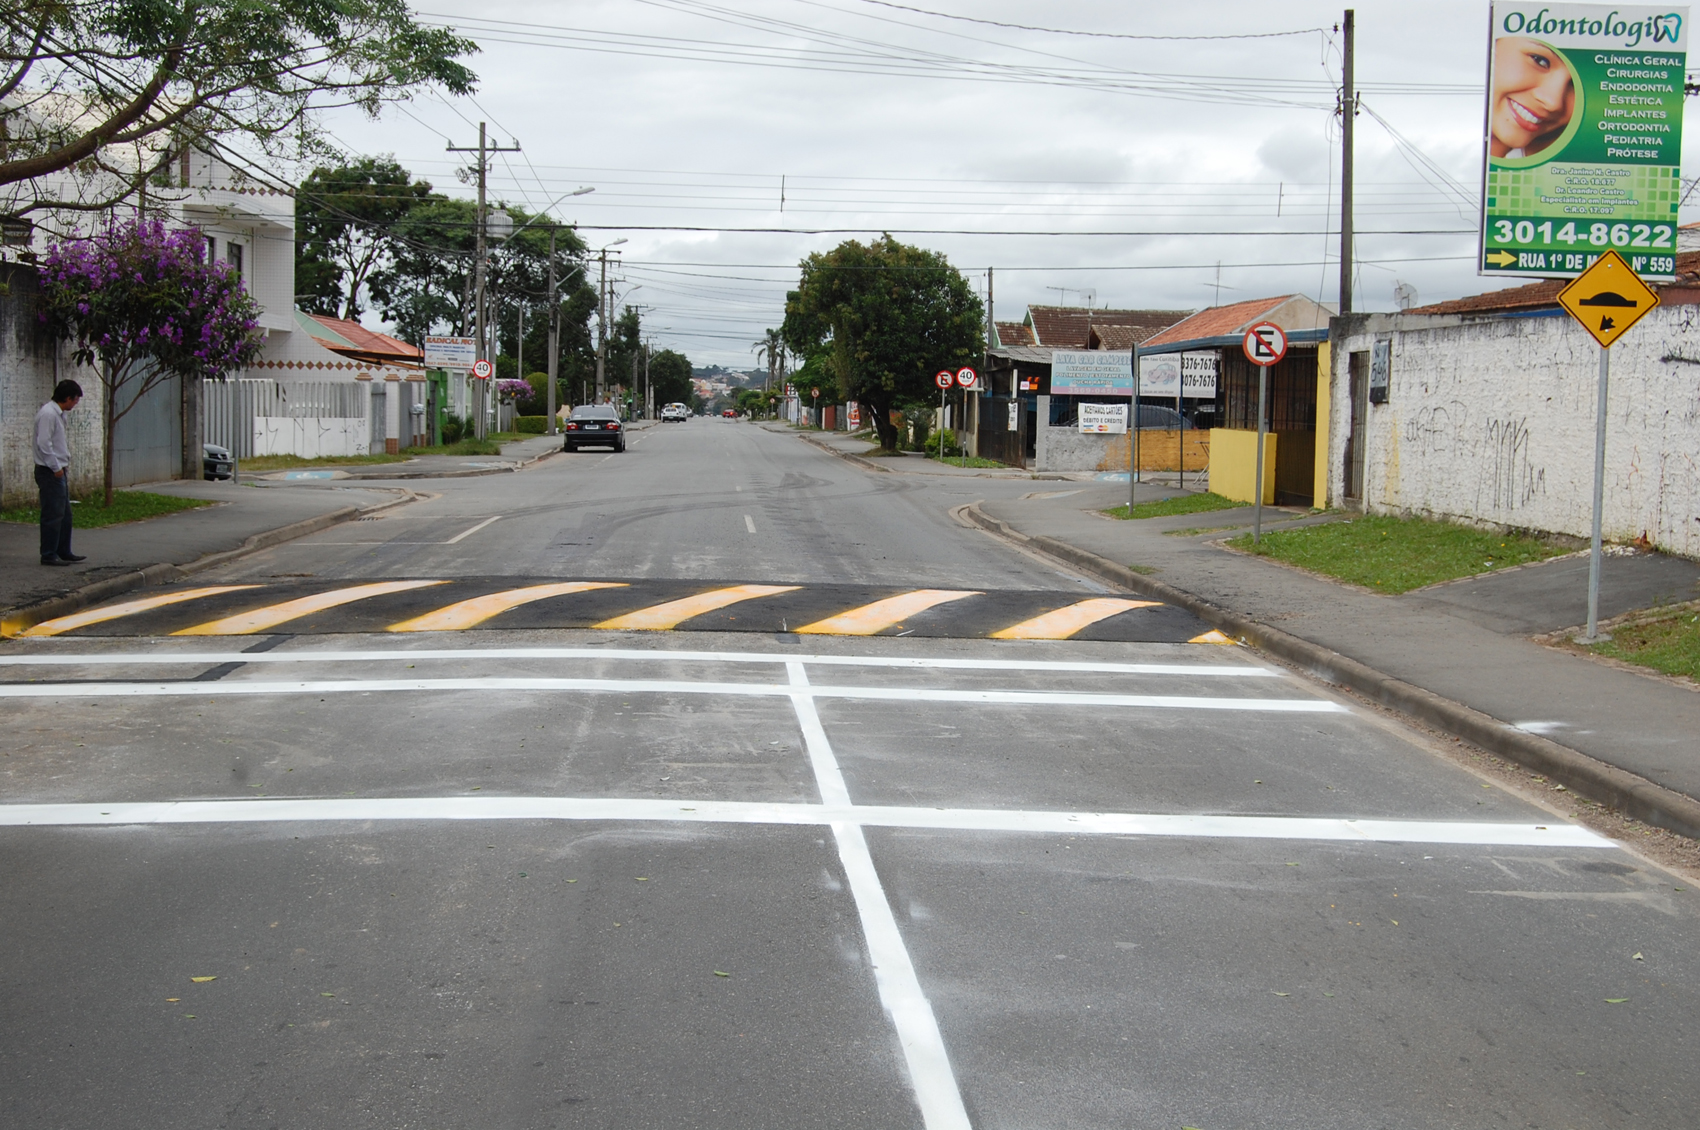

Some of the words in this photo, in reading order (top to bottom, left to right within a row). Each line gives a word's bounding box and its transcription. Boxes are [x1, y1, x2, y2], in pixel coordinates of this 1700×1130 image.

[1594, 54, 1640, 65] CLÍNICA
[1642, 56, 1682, 67] GERAL
[1606, 68, 1668, 79] CIRURGIAS
[1600, 81, 1673, 93] ENDODONTIA
[1609, 94, 1663, 105] ESTÉTICA
[1604, 108, 1667, 119] IMPLANTES
[1598, 121, 1670, 132] ORTODONTIA
[1604, 135, 1663, 145] PEDIATRIA
[1607, 147, 1659, 158] PRÓTESE
[1551, 167, 1567, 175] Dra.
[1568, 168, 1594, 176] Janine
[1605, 168, 1631, 177] Castro
[1555, 186, 1566, 194] Dr.
[1567, 187, 1598, 195] Leandro
[1599, 187, 1625, 196] Castro
[1540, 195, 1587, 204] Especialista
[1601, 197, 1639, 206] Implantes
[1493, 220, 1672, 248] 3014-8622
[1518, 253, 1546, 268] RUA
[1565, 254, 1583, 269] DE
[1650, 257, 1673, 272] 559
[426, 337, 459, 345] RADICAL
[1055, 354, 1076, 365] LAVA
[1078, 354, 1095, 365] CAR
[476, 364, 489, 372] 40
[959, 371, 972, 379] 40
[1182, 374, 1216, 387] 076-7676
